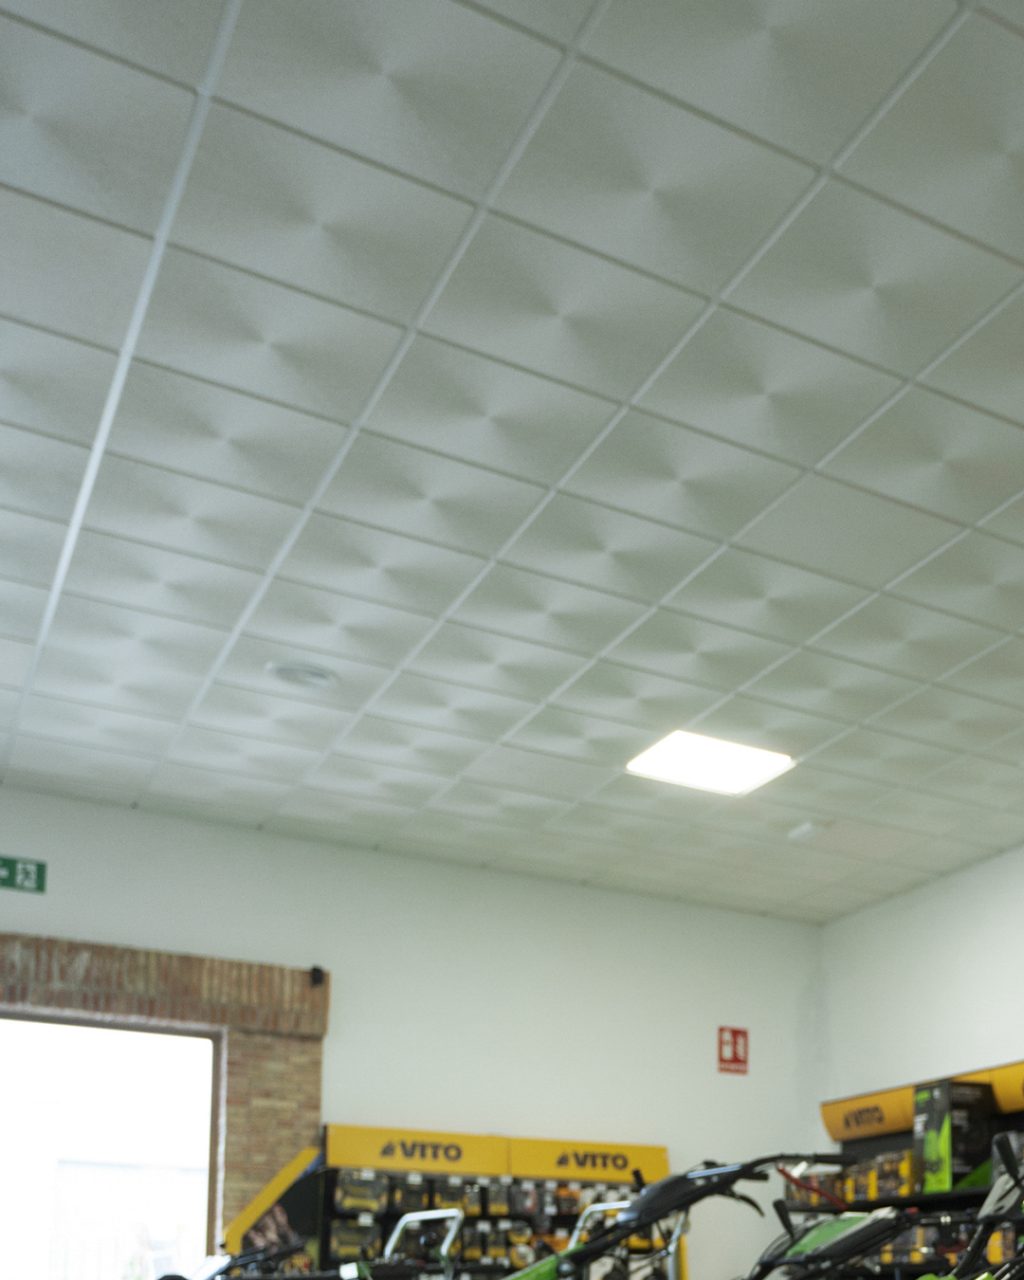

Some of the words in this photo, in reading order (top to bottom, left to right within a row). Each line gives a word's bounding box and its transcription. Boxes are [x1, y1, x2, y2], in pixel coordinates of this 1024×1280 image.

[852, 1105, 885, 1127] VITO
[398, 1141, 463, 1161] VITO
[573, 1152, 629, 1170] VITO
